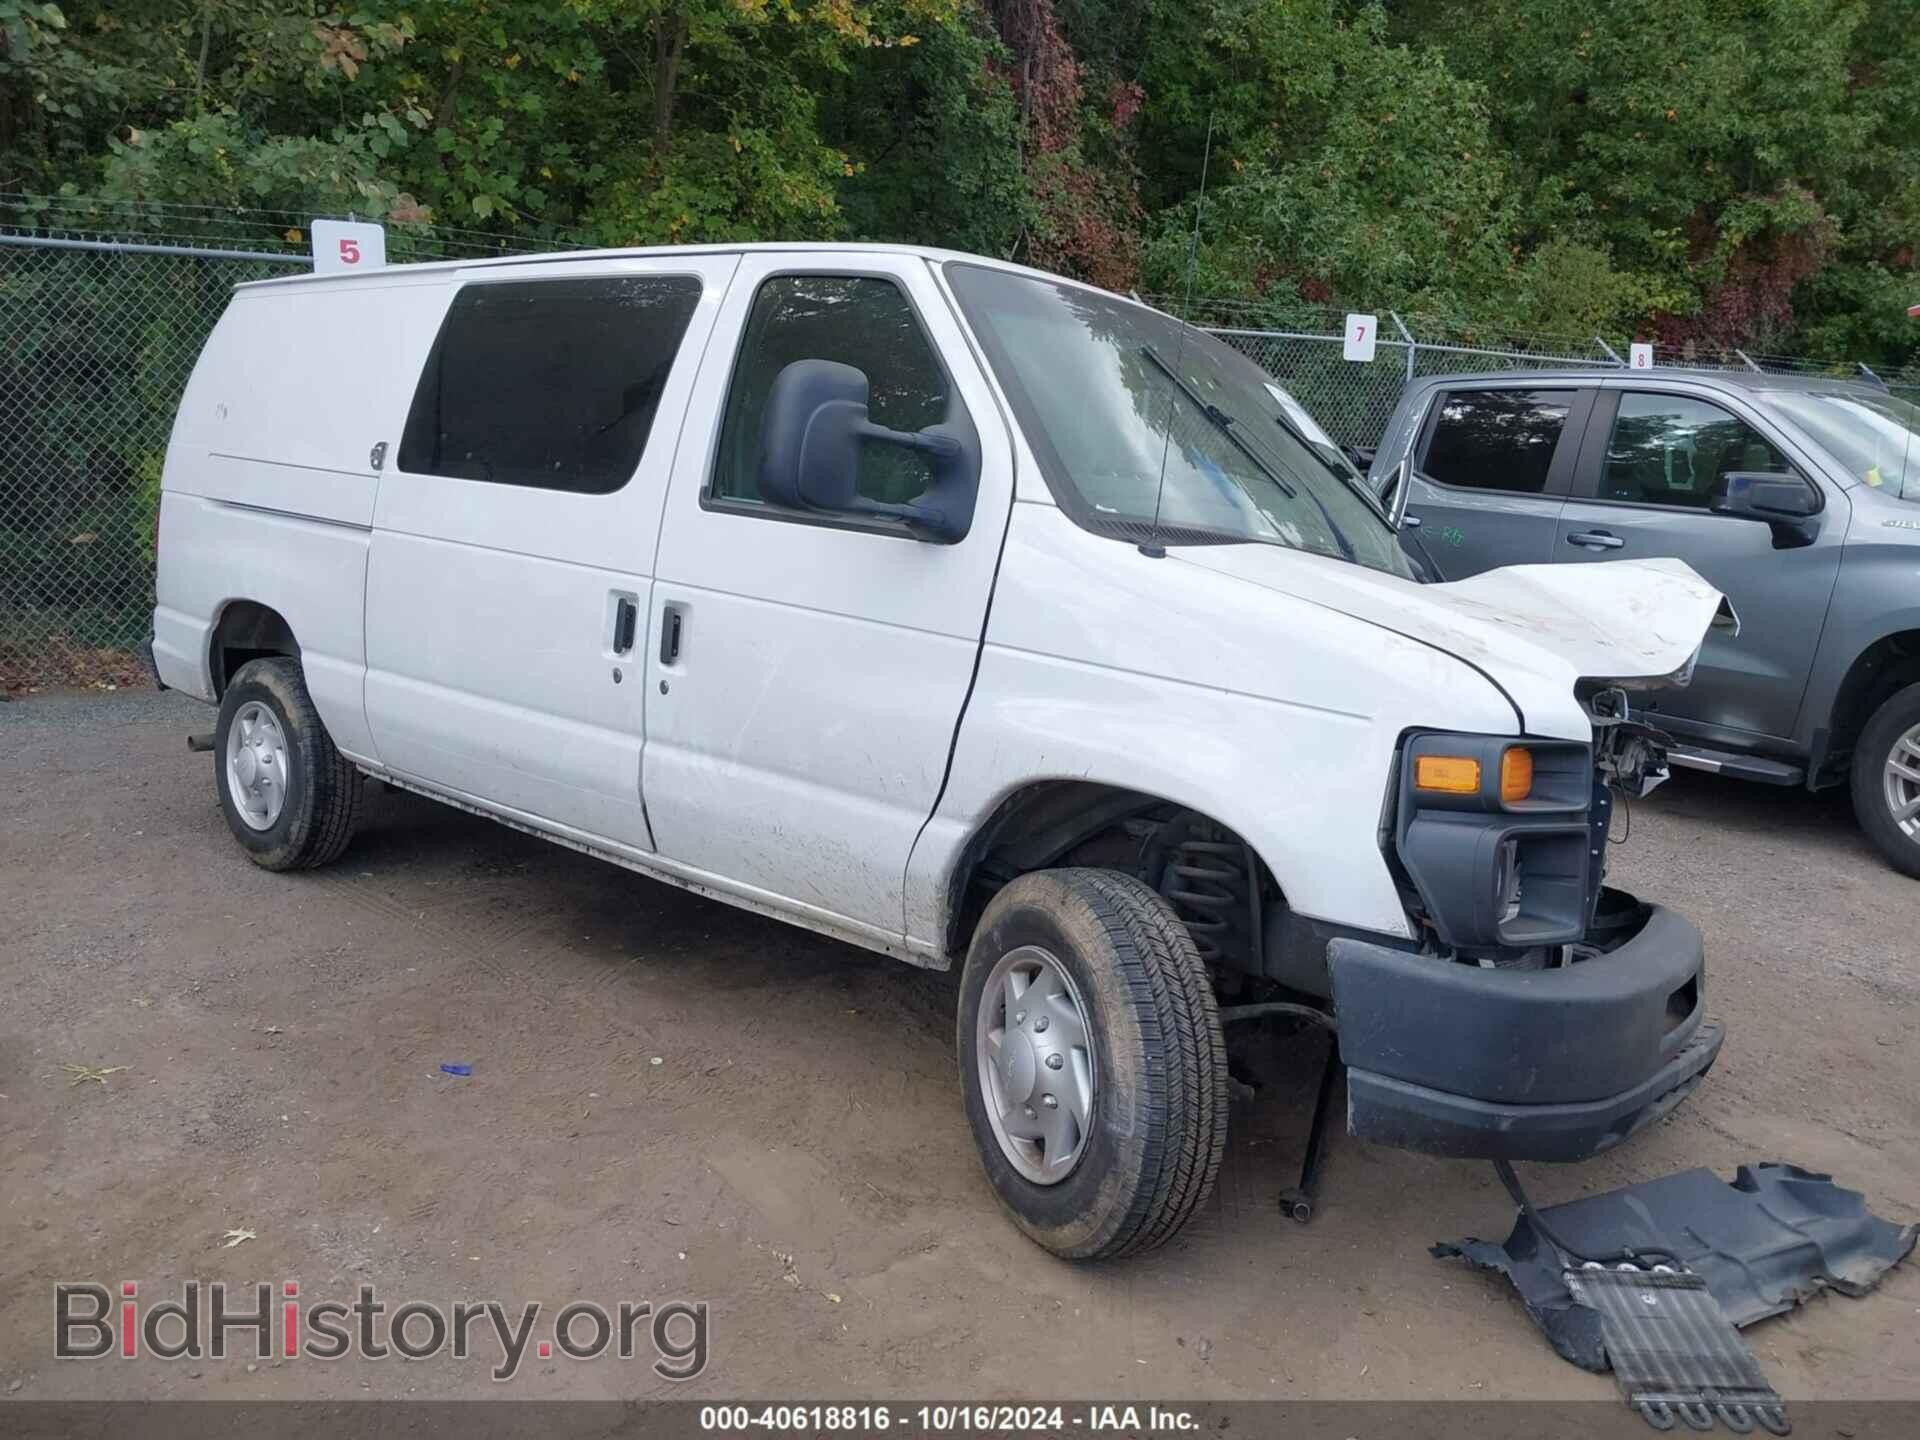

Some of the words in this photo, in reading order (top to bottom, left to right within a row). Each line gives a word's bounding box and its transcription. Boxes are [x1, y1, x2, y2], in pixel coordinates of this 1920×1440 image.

[339, 239, 360, 264] 5
[1356, 326, 1366, 342] 7
[1638, 353, 1645, 367] 8
